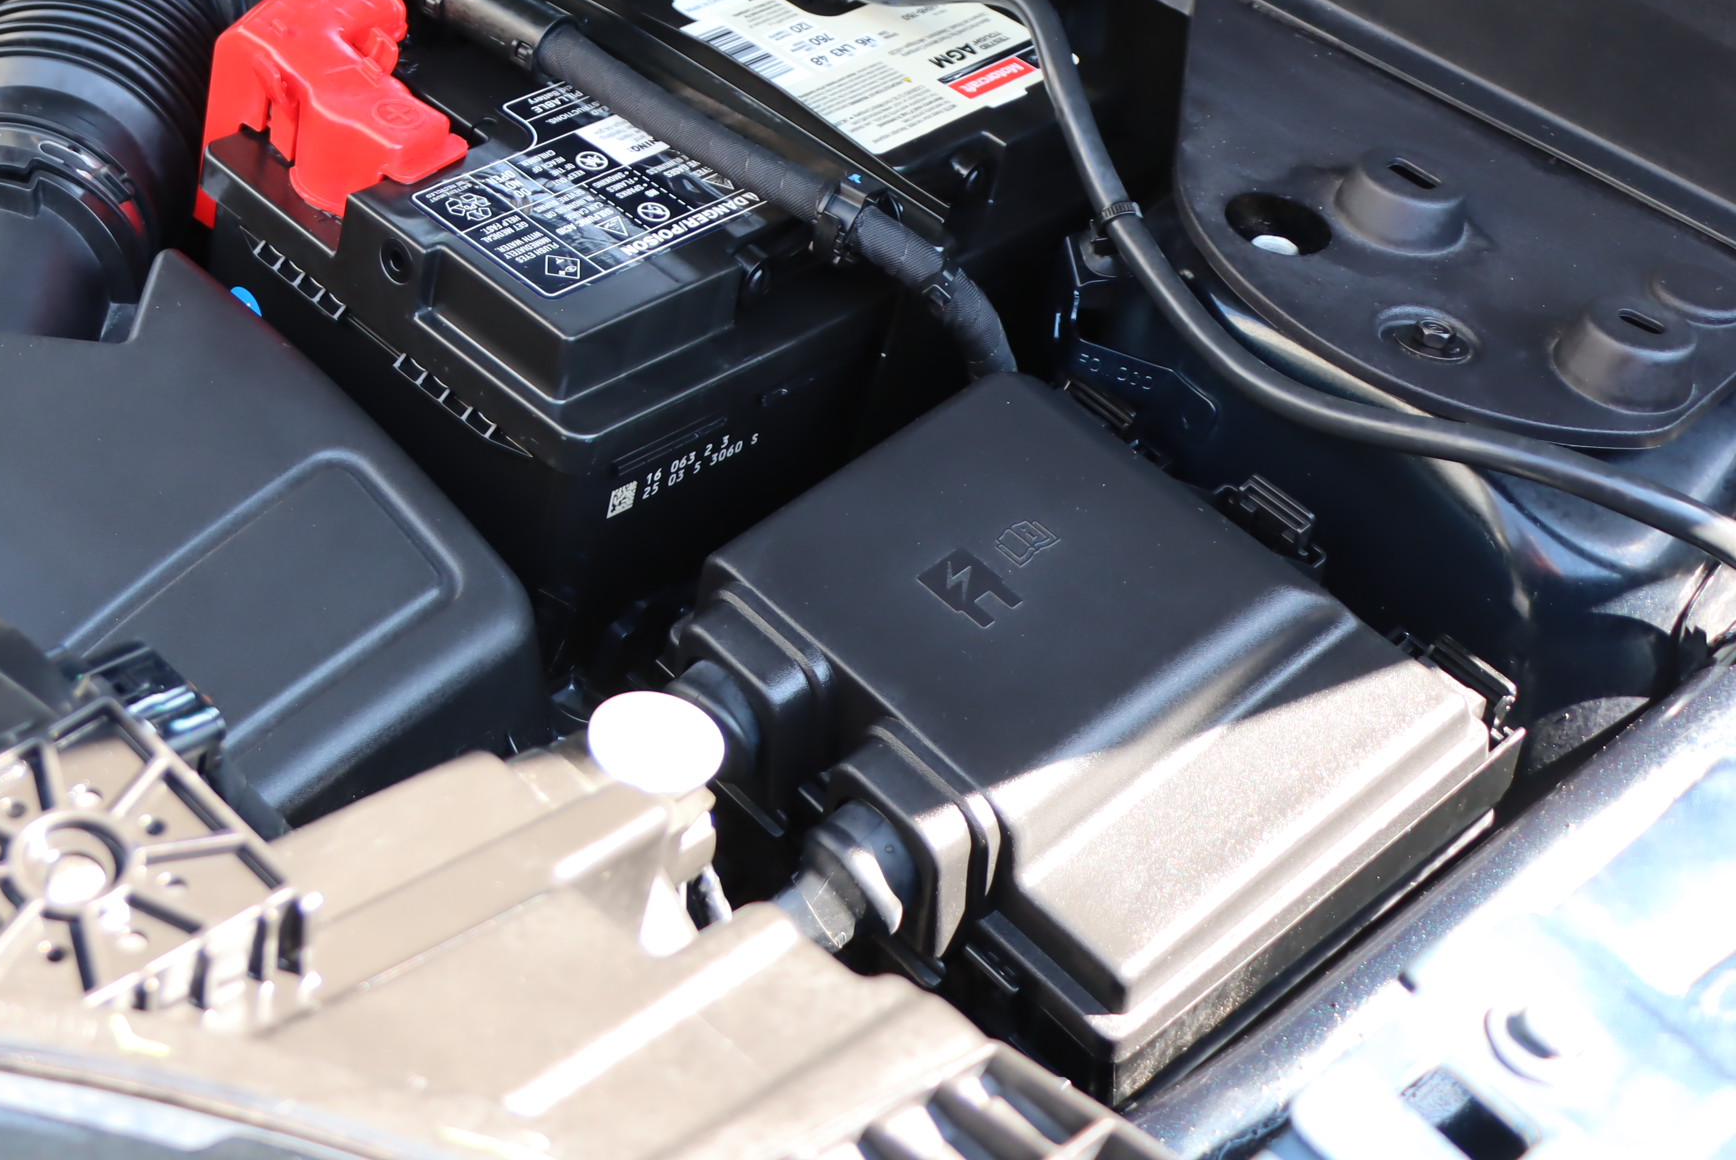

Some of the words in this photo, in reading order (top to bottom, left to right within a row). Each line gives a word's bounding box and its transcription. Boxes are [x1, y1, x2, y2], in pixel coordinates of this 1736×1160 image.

[789, 21, 813, 33] 120
[809, 33, 834, 46] 760
[855, 35, 874, 46] H6
[979, 34, 1011, 50] TESTED
[829, 43, 856, 57] LN3
[928, 43, 977, 69] AGM
[810, 55, 829, 66] 48
[958, 62, 1026, 92] Motorcraft
[527, 90, 561, 105] Battery
[531, 90, 584, 113] PILLABLE
[545, 101, 600, 125] STRUCTIONS.
[590, 105, 609, 116] EAD
[627, 138, 657, 153] NING:
[517, 150, 556, 166] CHILDREN.
[543, 156, 566, 168] REACH
[532, 165, 544, 174] OF
[549, 167, 565, 177] THE
[564, 162, 576, 171] OF
[646, 156, 682, 175] BLINDNESS
[663, 164, 689, 178] GASES
[481, 170, 516, 185] OPEN.
[567, 169, 586, 180] KEEP
[592, 171, 625, 188] SMOKING
[504, 179, 525, 192] NOT
[552, 177, 568, 186] OUT
[605, 178, 634, 192] FLAMES
[425, 183, 457, 199] RECYCLED
[447, 182, 473, 195] BATTERY
[514, 187, 532, 198] DO
[615, 185, 644, 199] SPARKS
[644, 188, 660, 198] NO
[429, 192, 447, 203] MUST
[558, 189, 587, 202] SEVERE
[555, 195, 595, 214] BLINDNESS
[589, 201, 605, 211] CAN
[502, 214, 522, 225] HELP
[543, 211, 557, 219] OR
[564, 207, 590, 220] CAUSE
[575, 208, 615, 227] SULFURIC
[480, 222, 503, 235] FAST.
[514, 221, 529, 231] GET
[555, 223, 577, 235] ACID
[619, 196, 750, 256] DANGER/POISON
[480, 227, 514, 243] MEDICAL
[522, 231, 544, 244] WITH
[494, 238, 523, 253] WATER.
[504, 236, 552, 260] IMMEDIATELY
[535, 242, 560, 258] FLUSH
[514, 250, 535, 263] EYES
[1079, 353, 1153, 390] FOOCO
[646, 467, 663, 485] 16
[670, 451, 697, 473] 063
[703, 443, 713, 457] 2
[720, 434, 731, 449] 3
[641, 482, 661, 500] 25
[667, 468, 685, 487] 03
[692, 460, 702, 475] 5
[709, 440, 744, 466] 3060
